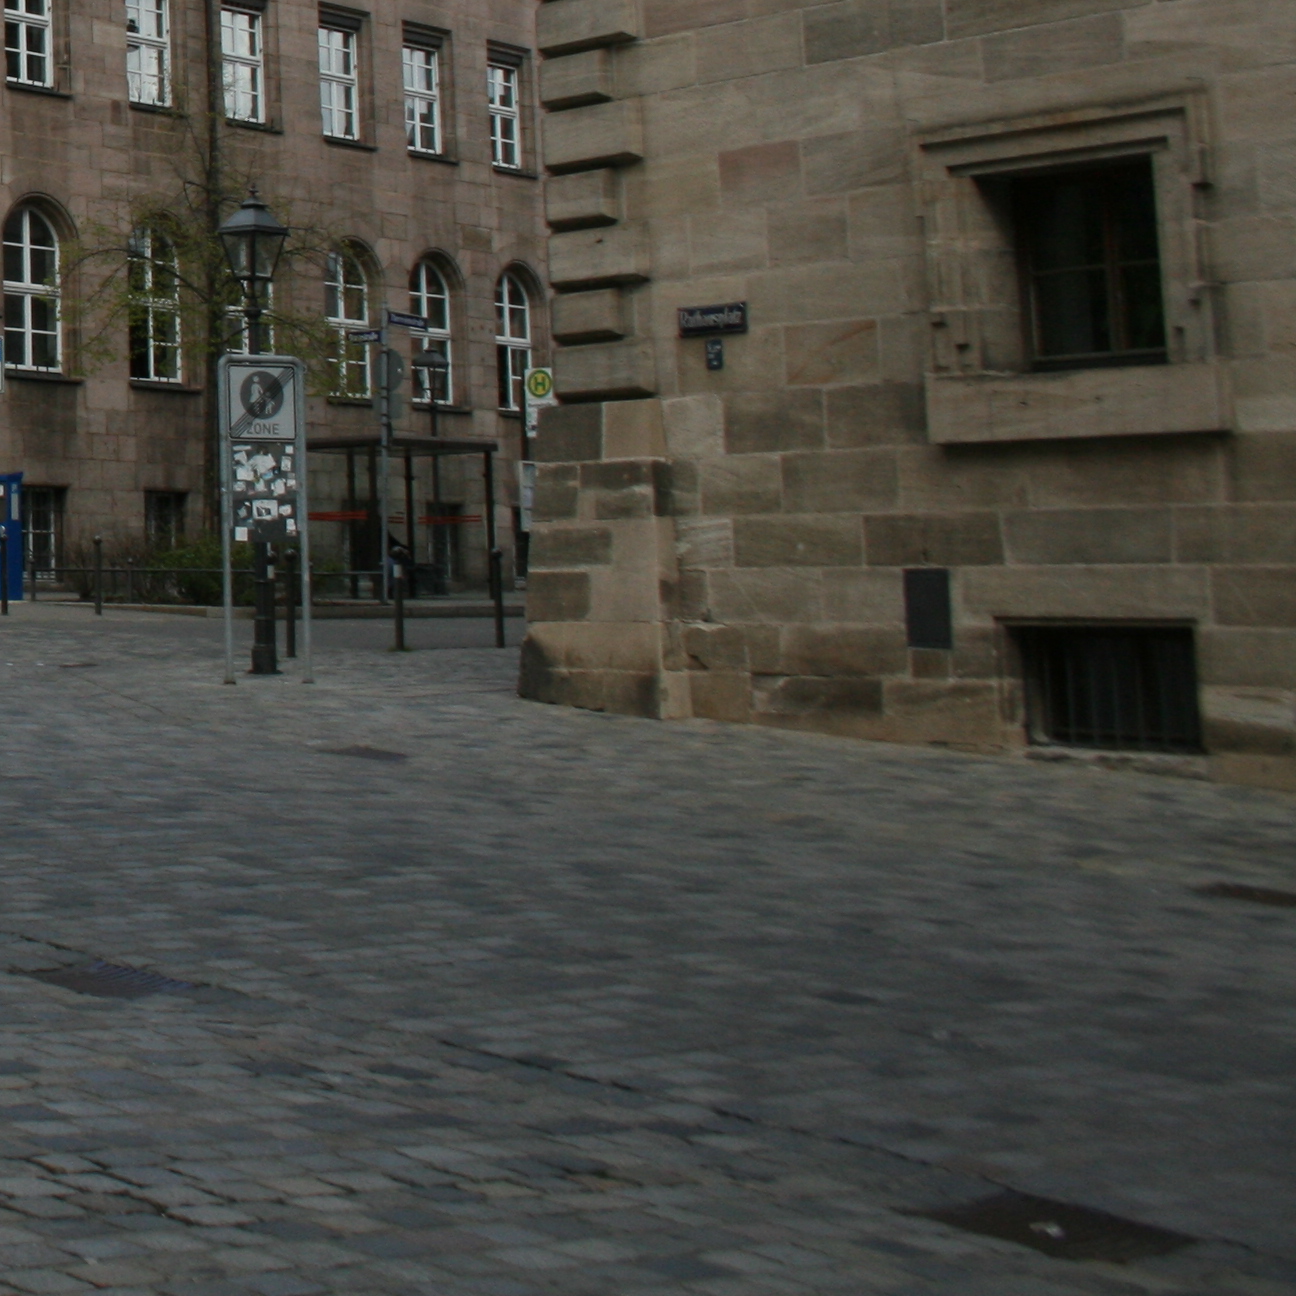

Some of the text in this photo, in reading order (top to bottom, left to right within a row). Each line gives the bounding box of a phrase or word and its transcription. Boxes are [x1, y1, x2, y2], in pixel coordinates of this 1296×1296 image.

[680, 307, 742, 328] Rathausplatz
[533, 376, 546, 393] H
[246, 422, 280, 435] ZONE
